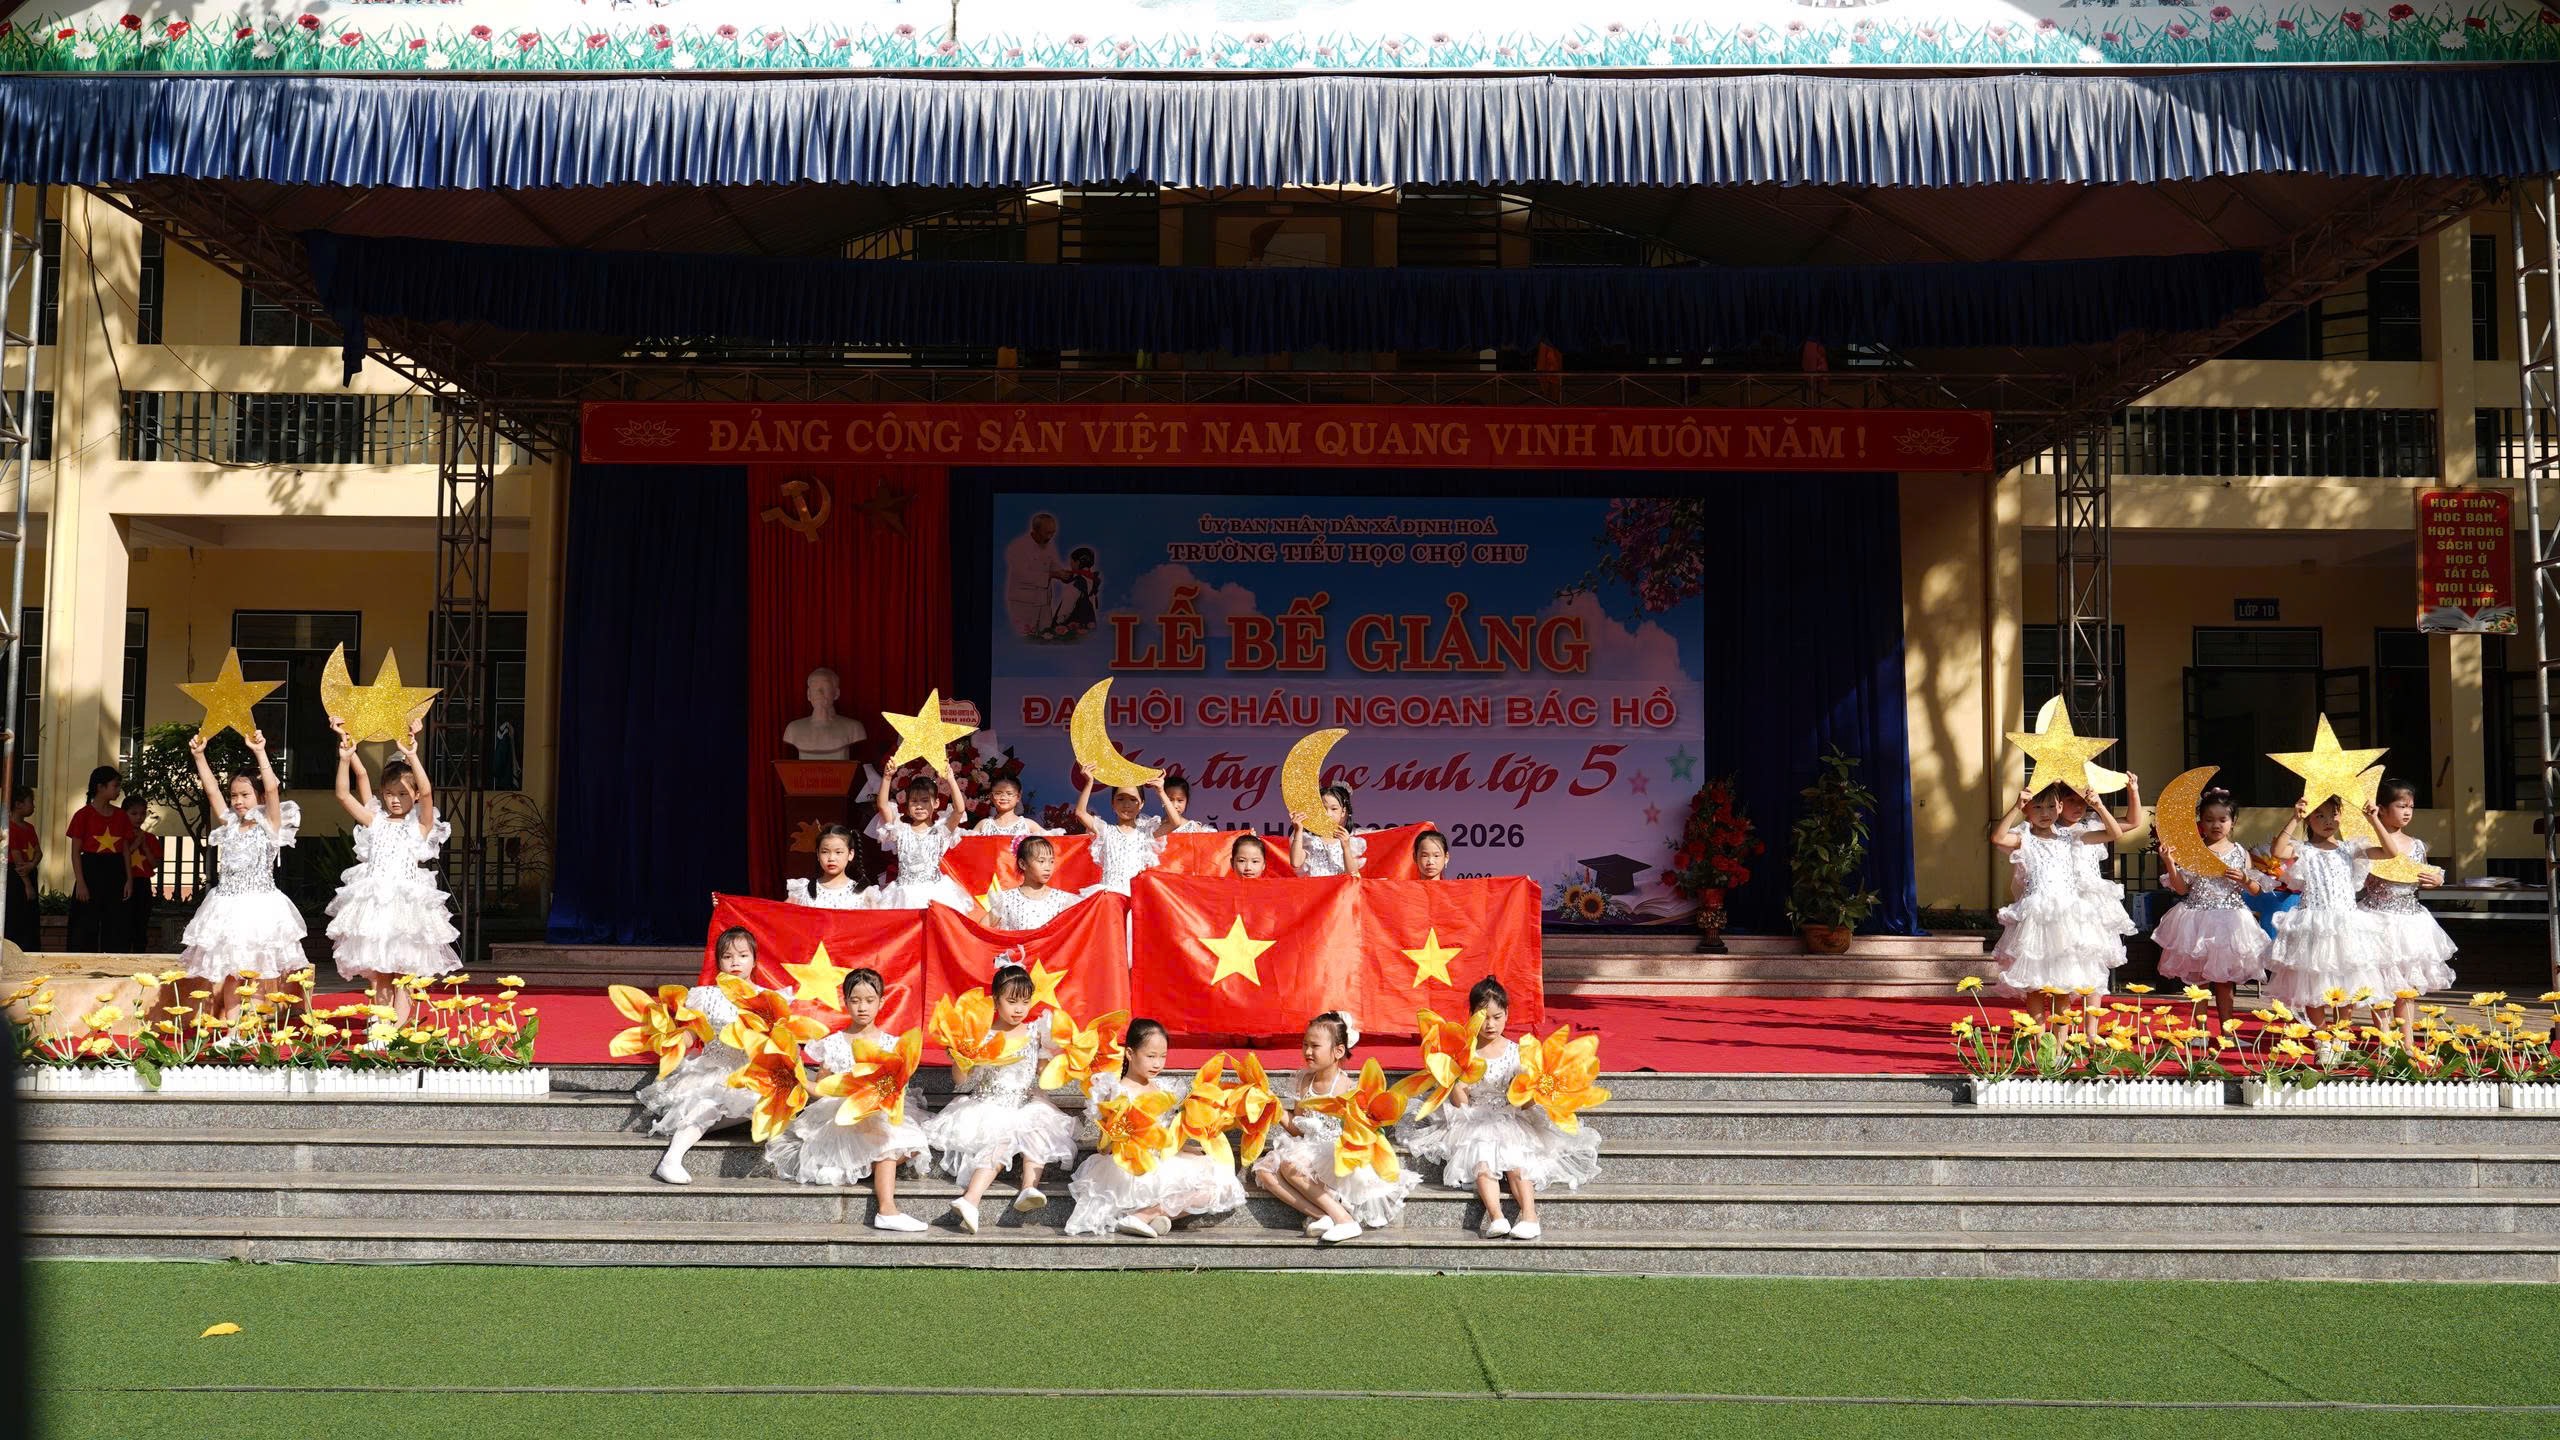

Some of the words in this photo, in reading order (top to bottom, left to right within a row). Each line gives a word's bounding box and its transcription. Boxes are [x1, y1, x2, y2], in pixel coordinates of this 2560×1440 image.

[708, 407, 832, 452] ĐẢNG
[845, 411, 963, 460] CỘNG
[976, 408, 1066, 453] SẢN
[1080, 411, 1188, 460] VIỆT
[1202, 421, 1302, 454] NAM
[1314, 421, 1471, 456] QUANG
[1484, 423, 1597, 456] VINH
[1609, 416, 1732, 458] MUÔN
[1744, 416, 1845, 458] NĂM
[1855, 425, 1867, 458] !
[2431, 498, 2458, 509] HỌC
[1200, 514, 1225, 532] ỦY
[1230, 519, 1267, 533] BAN
[1273, 516, 1326, 533] NHÂN
[1331, 516, 1369, 533] DÂN
[1374, 517, 1398, 533] XÃ
[1403, 519, 1450, 536] ĐỊNH
[1455, 516, 1497, 533] HOÁ
[2434, 512, 2461, 524] HỌC
[2428, 526, 2455, 537] HỌC
[2460, 526, 2504, 537] TRONG
[1168, 538, 1276, 561] TRƯỜNG
[1283, 536, 1343, 562] TIỂU
[1351, 544, 1404, 565] HỌC
[1412, 543, 1467, 566] CHỢ
[1473, 545, 1527, 562] CHU
[2437, 539, 2473, 550] SÁCH
[2446, 554, 2473, 566] HỌC
[2472, 566, 2490, 578] CẢ
[2435, 583, 2464, 594] MỌI
[2239, 601, 2258, 617] LỚP
[1109, 586, 1206, 670] LỄ
[1225, 591, 1331, 670] BẾ
[1346, 592, 1591, 672] GIẢNG
[1023, 696, 1072, 732] ĐẠ
[1110, 688, 1185, 731] HỘI
[1198, 689, 1322, 727] CHÁU
[1333, 695, 1491, 728] NGOAN
[1506, 689, 1598, 728] BÁC
[1612, 686, 1677, 729] HỒ
[1371, 752, 1475, 792] sinh
[1478, 752, 1559, 810] lớp
[1568, 744, 1629, 797] 5
[1451, 823, 1525, 848] 2026
